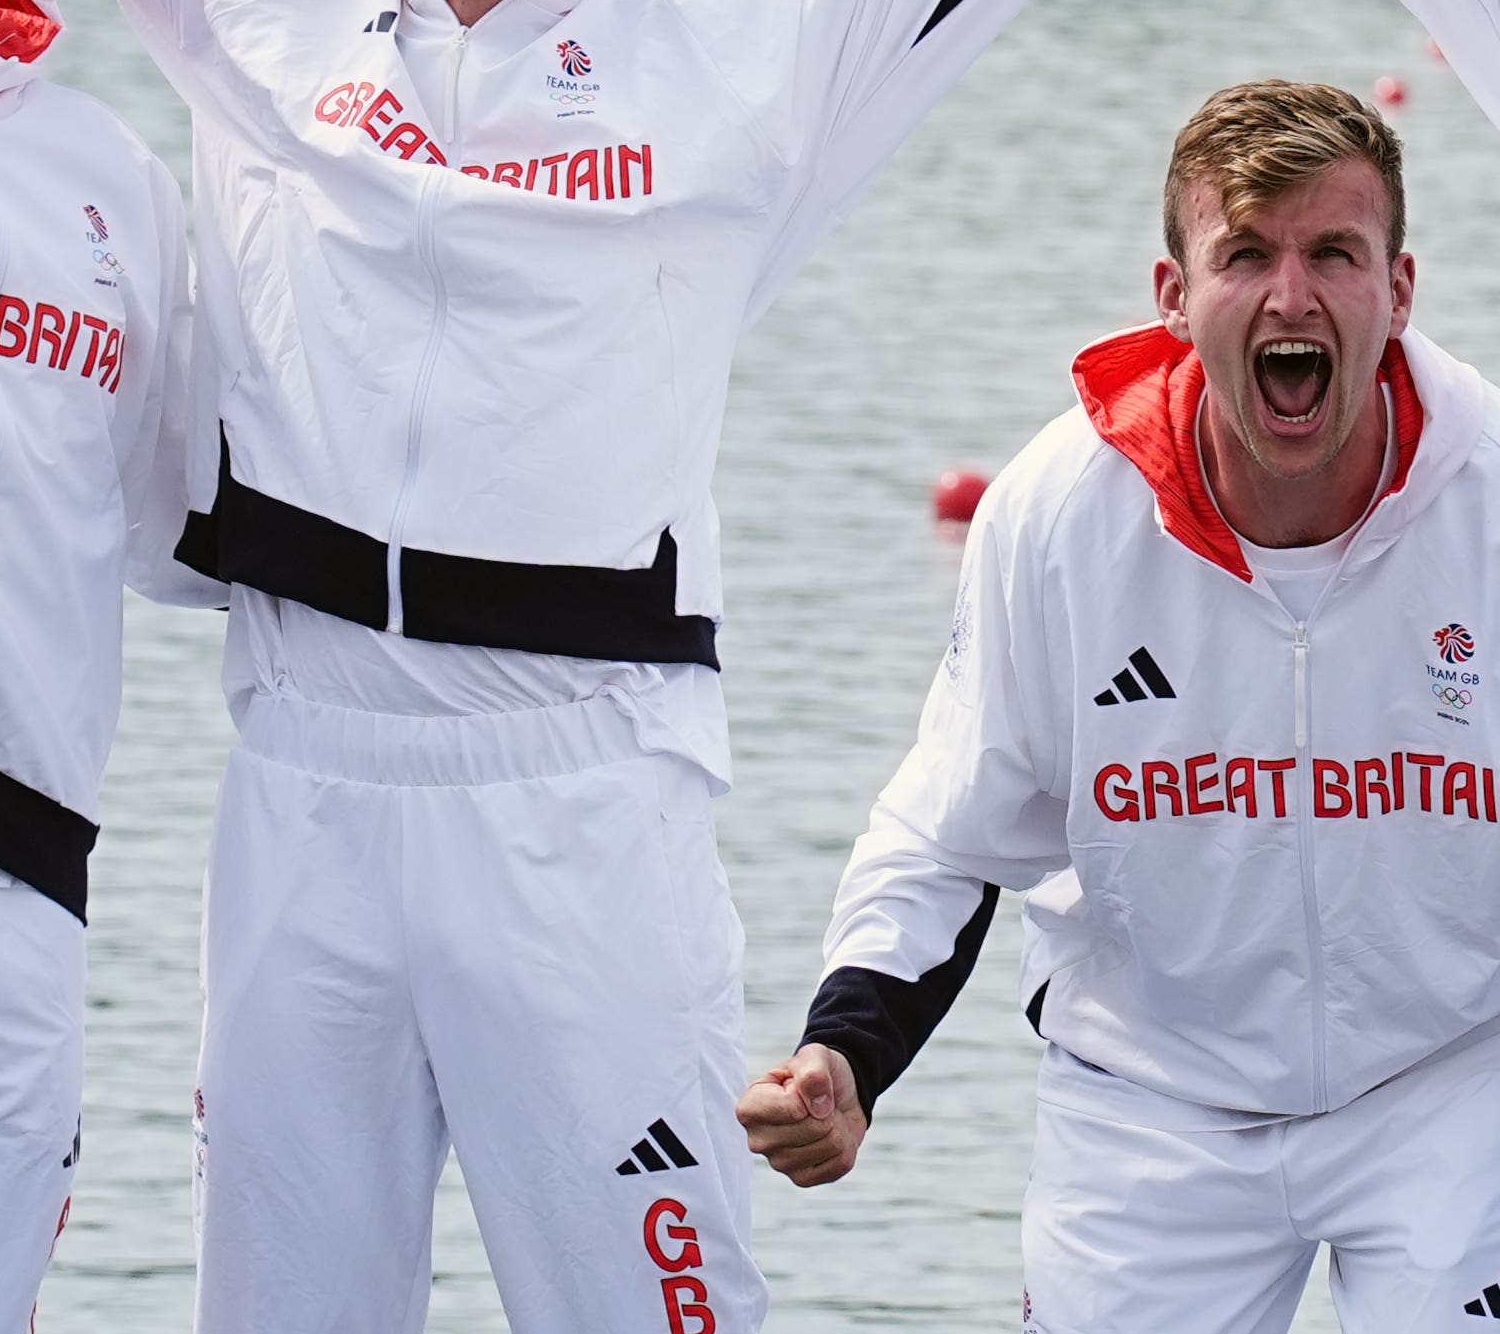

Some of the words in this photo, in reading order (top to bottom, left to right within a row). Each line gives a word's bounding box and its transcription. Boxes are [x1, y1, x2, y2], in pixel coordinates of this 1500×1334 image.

[546, 74, 578, 91] TEAM
[581, 84, 601, 92] GB
[86, 231, 104, 244] TEA
[1425, 664, 1457, 682] TEAM
[1461, 672, 1480, 685] GB
[1093, 752, 1296, 822] GREAT
